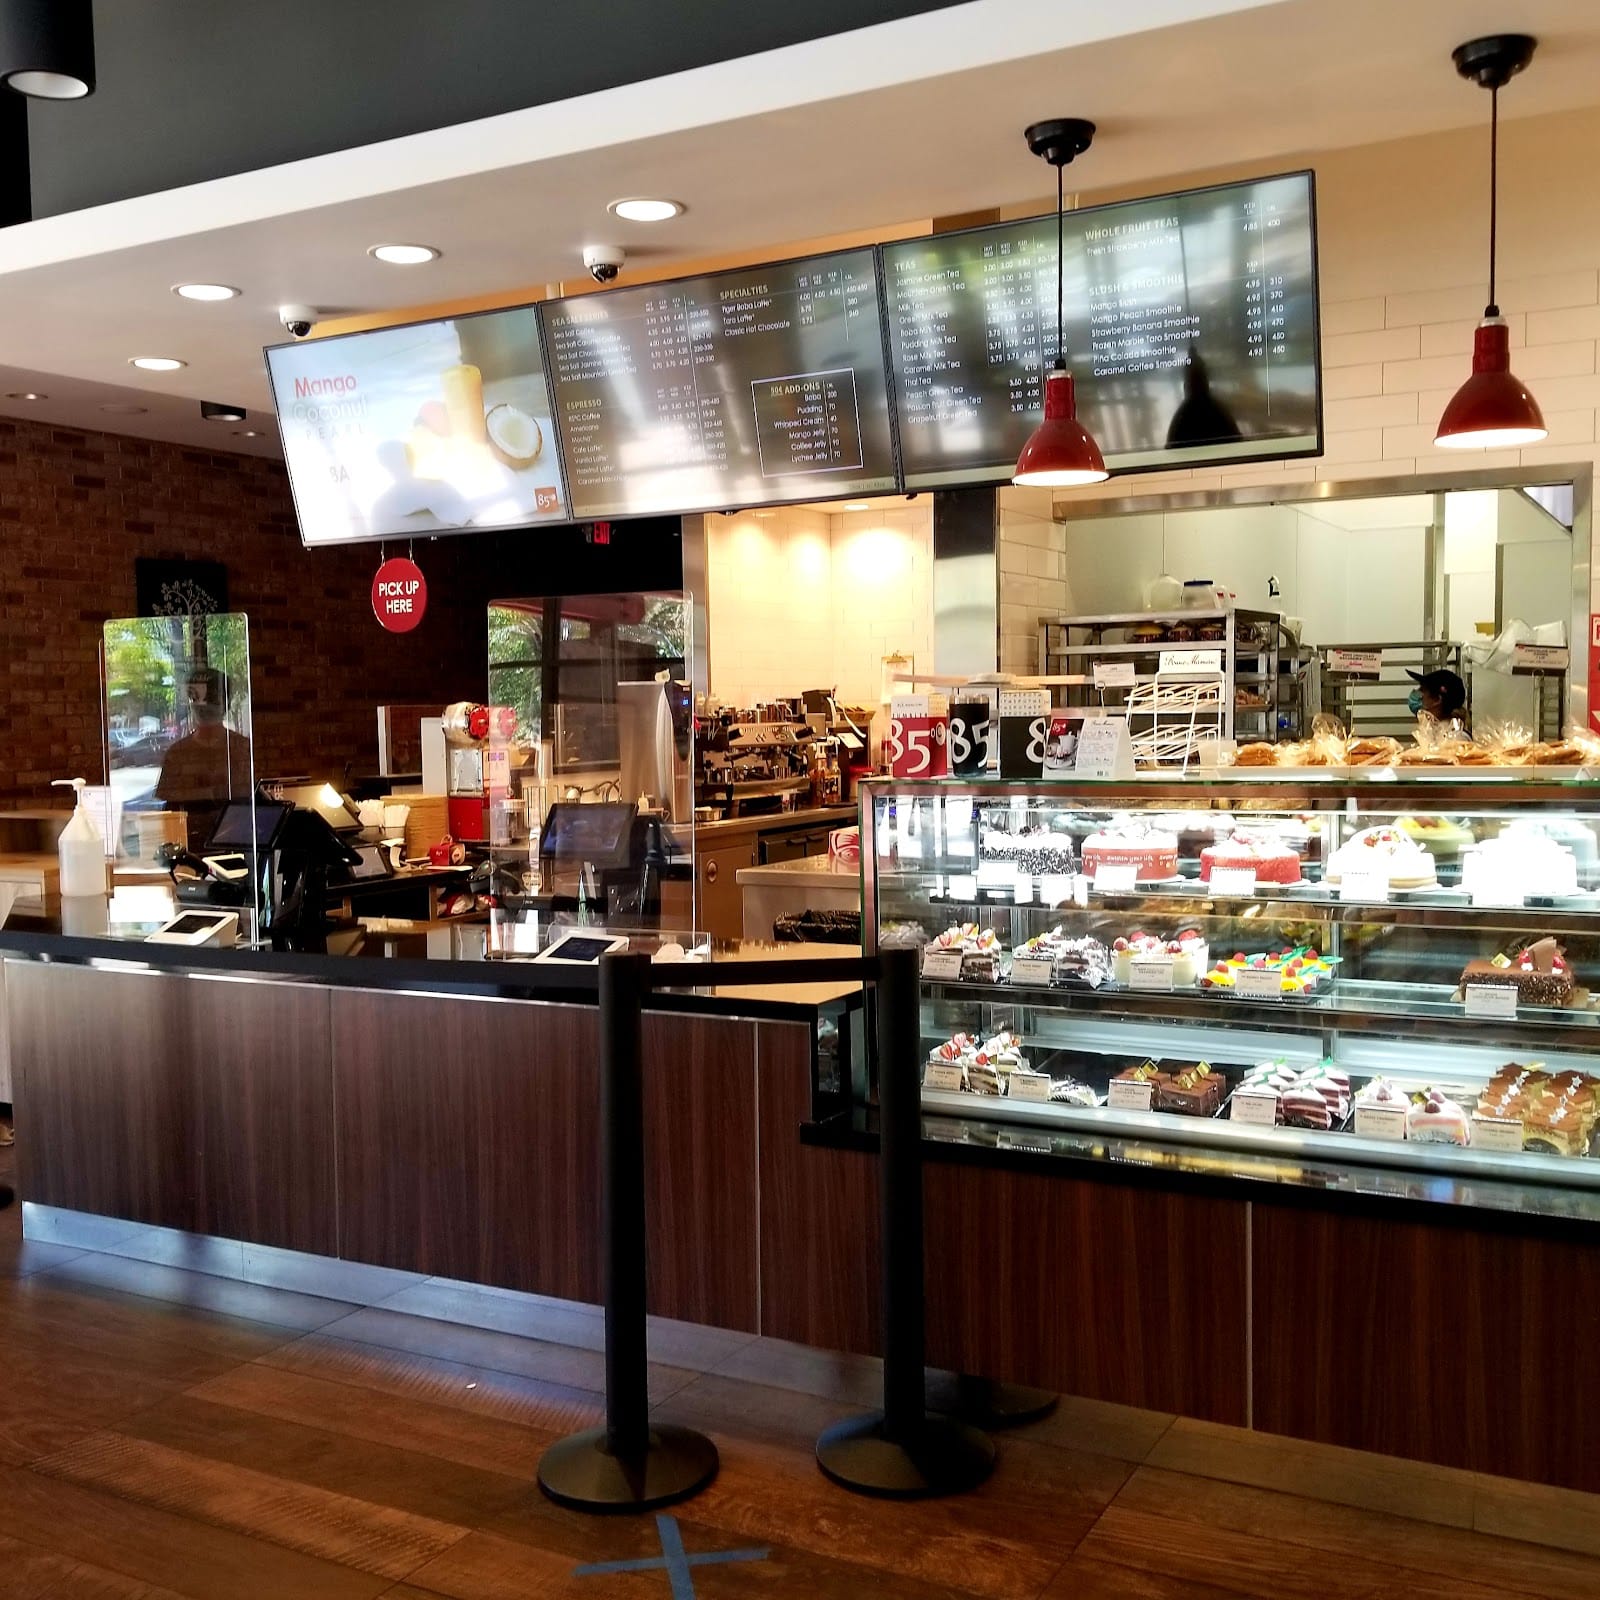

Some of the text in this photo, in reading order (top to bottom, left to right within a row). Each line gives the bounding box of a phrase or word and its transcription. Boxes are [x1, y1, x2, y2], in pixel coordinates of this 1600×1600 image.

[1086, 216, 1179, 241] WHOLE FRUIT TEAS
[895, 261, 916, 272] TEAS
[947, 270, 960, 278] Tea
[952, 282, 966, 290] Tea
[1246, 277, 1283, 289] 4.95 310
[720, 284, 769, 300] SPECIALTIES
[1088, 283, 1120, 297] SLUSH
[1246, 291, 1284, 303] 4.95 370
[737, 300, 754, 311] Boba
[913, 302, 925, 310] Tea
[1090, 302, 1118, 312] Mango
[1247, 304, 1284, 316] 4.95 410
[936, 311, 949, 319] Tea
[1091, 304, 1182, 325] Mango Peach Smoothie
[552, 317, 566, 327] SEA
[1091, 315, 1200, 339] Strawberry Banana Smoothie
[1247, 318, 1285, 330] 4.95 470
[724, 321, 791, 337] Classic Hot Chocolate
[944, 336, 957, 344] Tea
[1092, 329, 1201, 352] Frozen Marble Taro Smoothie
[1248, 335, 1263, 344] 4.95
[934, 350, 946, 358] Tea
[1007, 352, 1020, 361] 3.75
[1110, 345, 1177, 362] Colada Smoothie
[1249, 348, 1263, 358] 4.95
[903, 364, 933, 375] Caramel
[947, 361, 961, 369] Tea
[1094, 356, 1192, 377] Caramel Coffee Smoothie
[919, 377, 932, 386] Tea
[1026, 376, 1039, 384] 4.00
[294, 374, 357, 400] Mango
[784, 382, 821, 395] ADD-ONS
[951, 386, 964, 395] Tea
[805, 393, 822, 402] Boba
[1027, 389, 1040, 397] 4.00
[566, 399, 602, 411] ESPRESSO
[969, 396, 982, 405] Tea
[797, 403, 836, 415] Pudding 70
[1028, 402, 1041, 410] 4.00
[582, 412, 601, 421] Coffee
[965, 409, 978, 418] Tea
[570, 424, 600, 433] Americano
[774, 417, 825, 430] Whipped Cream
[789, 430, 811, 440] Mango
[791, 442, 813, 451] Coffee
[791, 454, 814, 463] Lychee
[594, 522, 610, 545] EXIT
[378, 580, 420, 597] PICK UP
[386, 598, 413, 615] HERE
